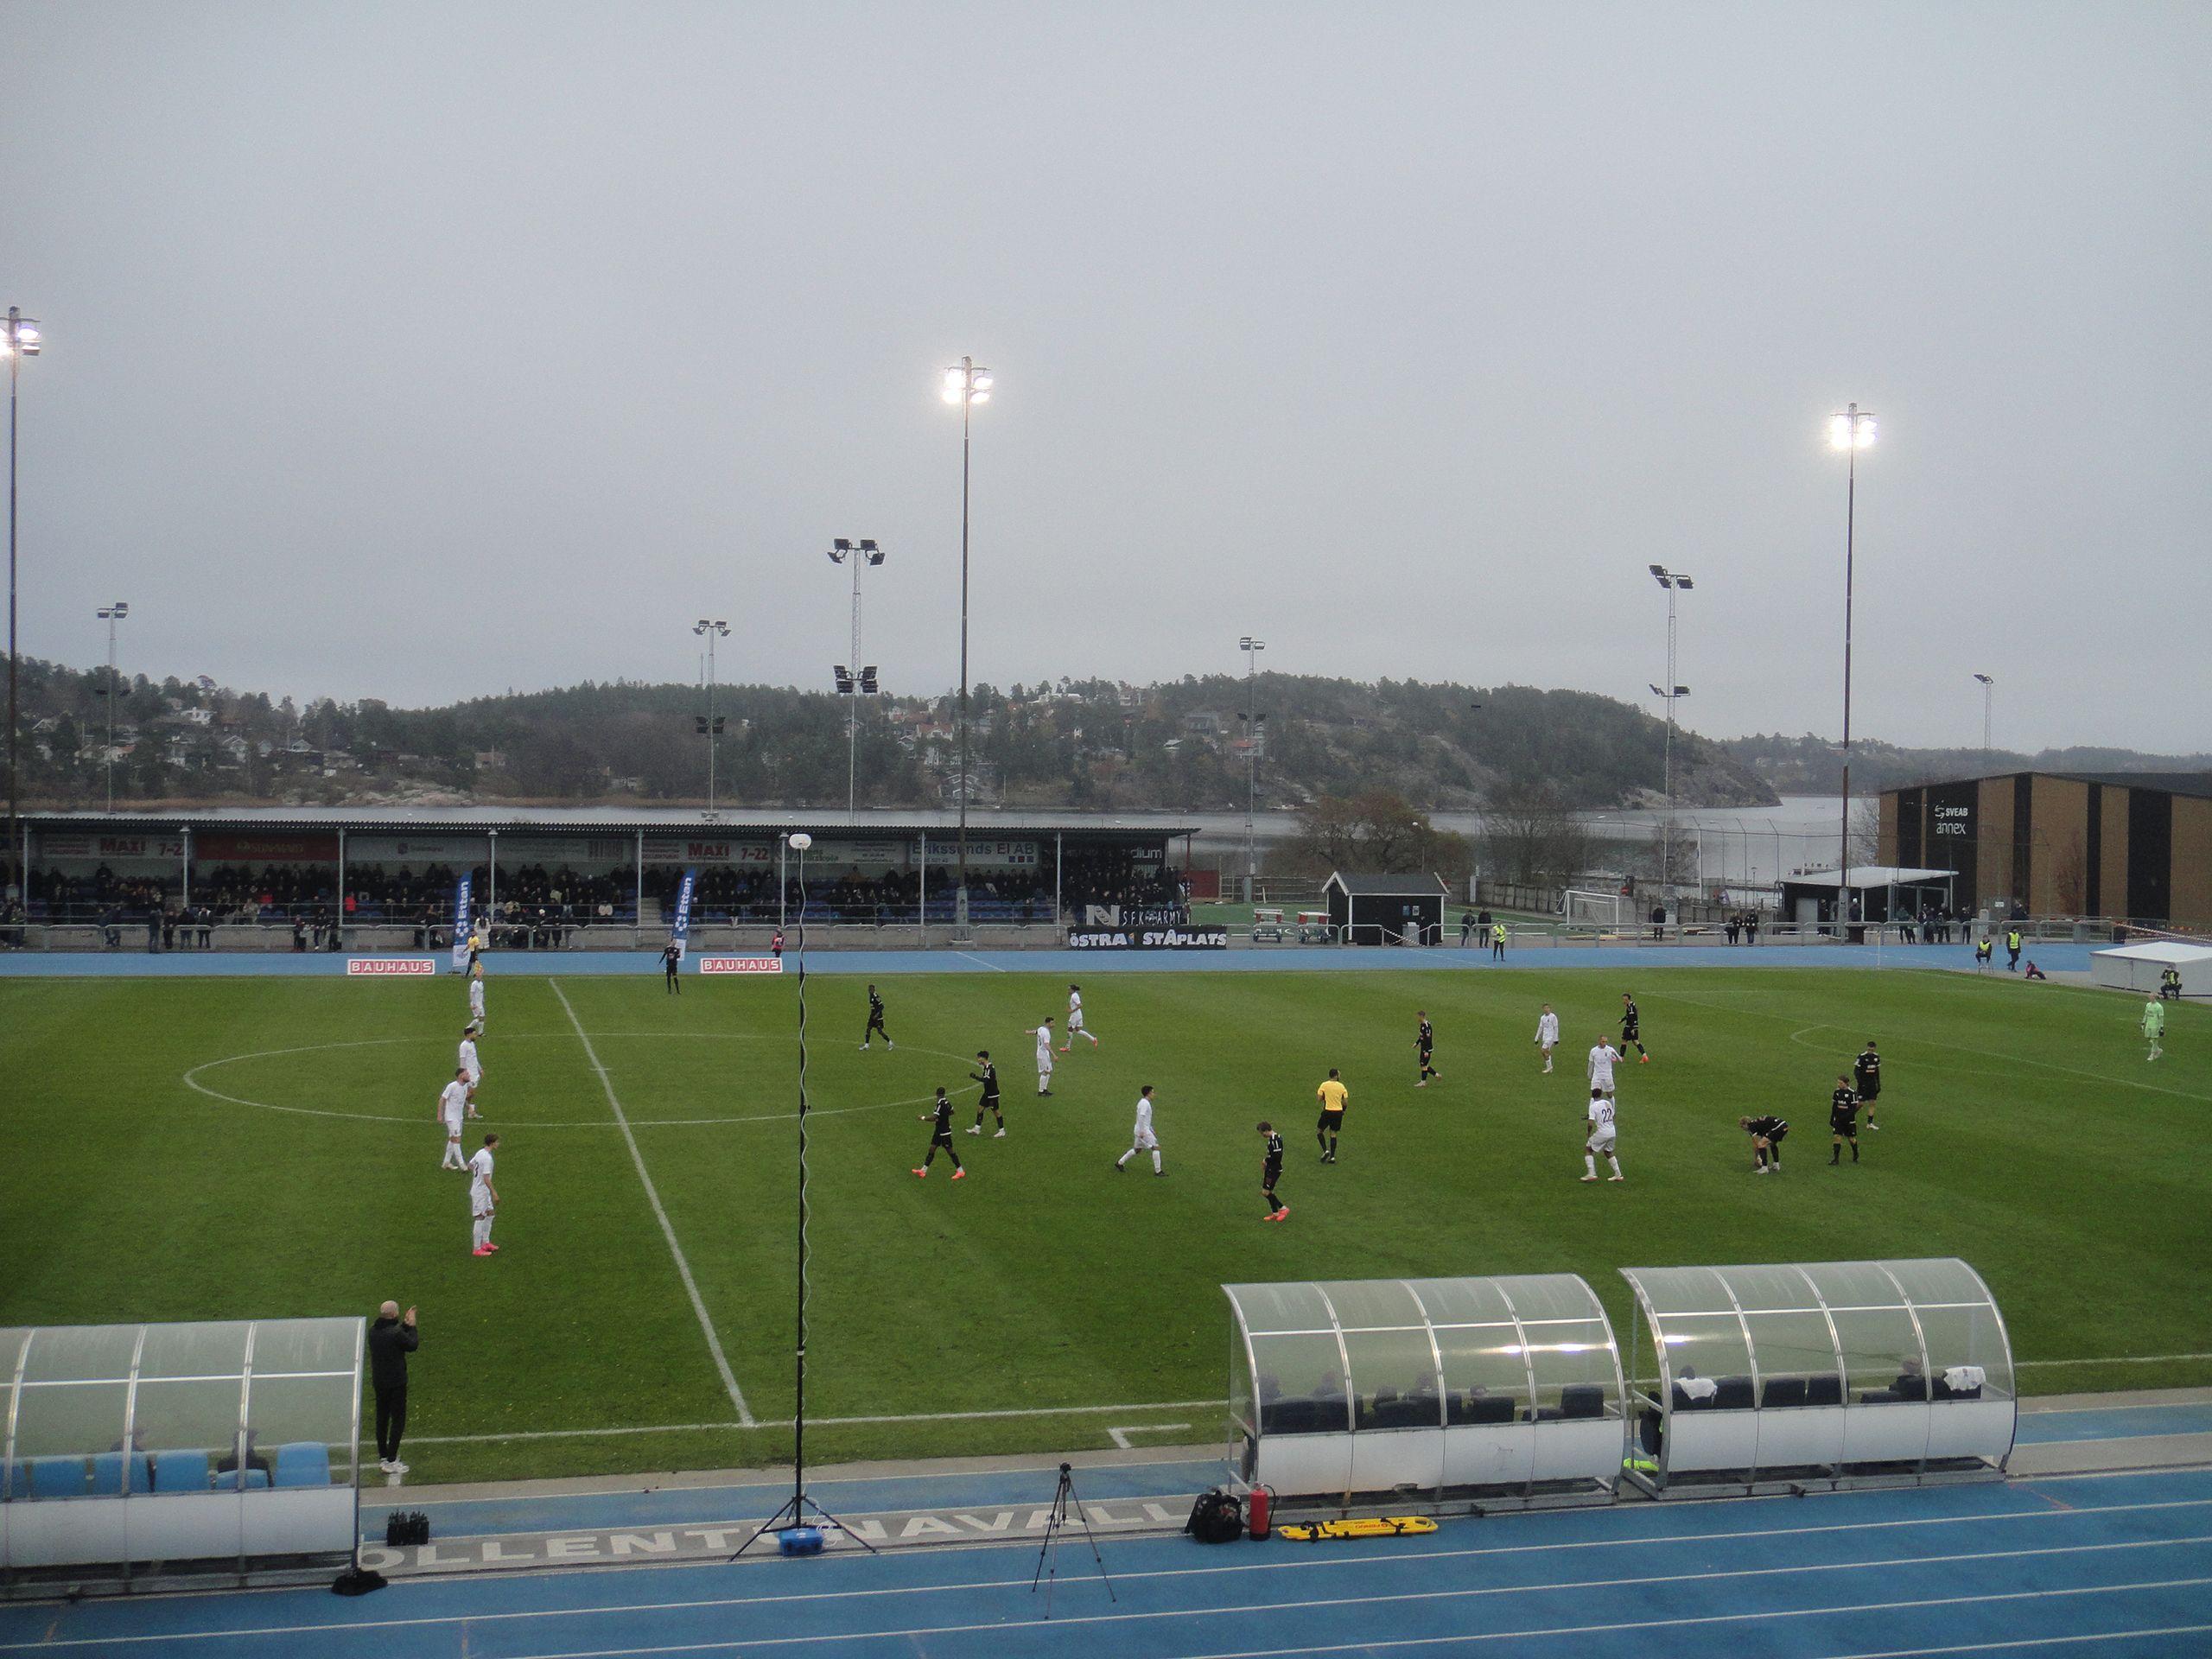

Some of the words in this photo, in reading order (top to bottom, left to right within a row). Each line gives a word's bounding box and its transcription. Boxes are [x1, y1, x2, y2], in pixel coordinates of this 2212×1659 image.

[1945, 807, 1968, 817] SVEAB
[1936, 822, 1967, 835] annex
[688, 842, 729, 856] MAXI
[741, 847, 768, 860] 7-22
[1014, 842, 1034, 855] AB
[1130, 846, 1162, 859] dium
[457, 880, 469, 919] Ettan
[678, 877, 692, 913] Ettan
[1156, 910, 1181, 925] ARMY
[1070, 932, 1128, 947] ÖSTRA
[1142, 929, 1227, 946] STÅPLATS
[351, 961, 433, 973] BAUHAUS
[703, 959, 779, 970] BAUHAUS
[1601, 1108, 1612, 1123] 22
